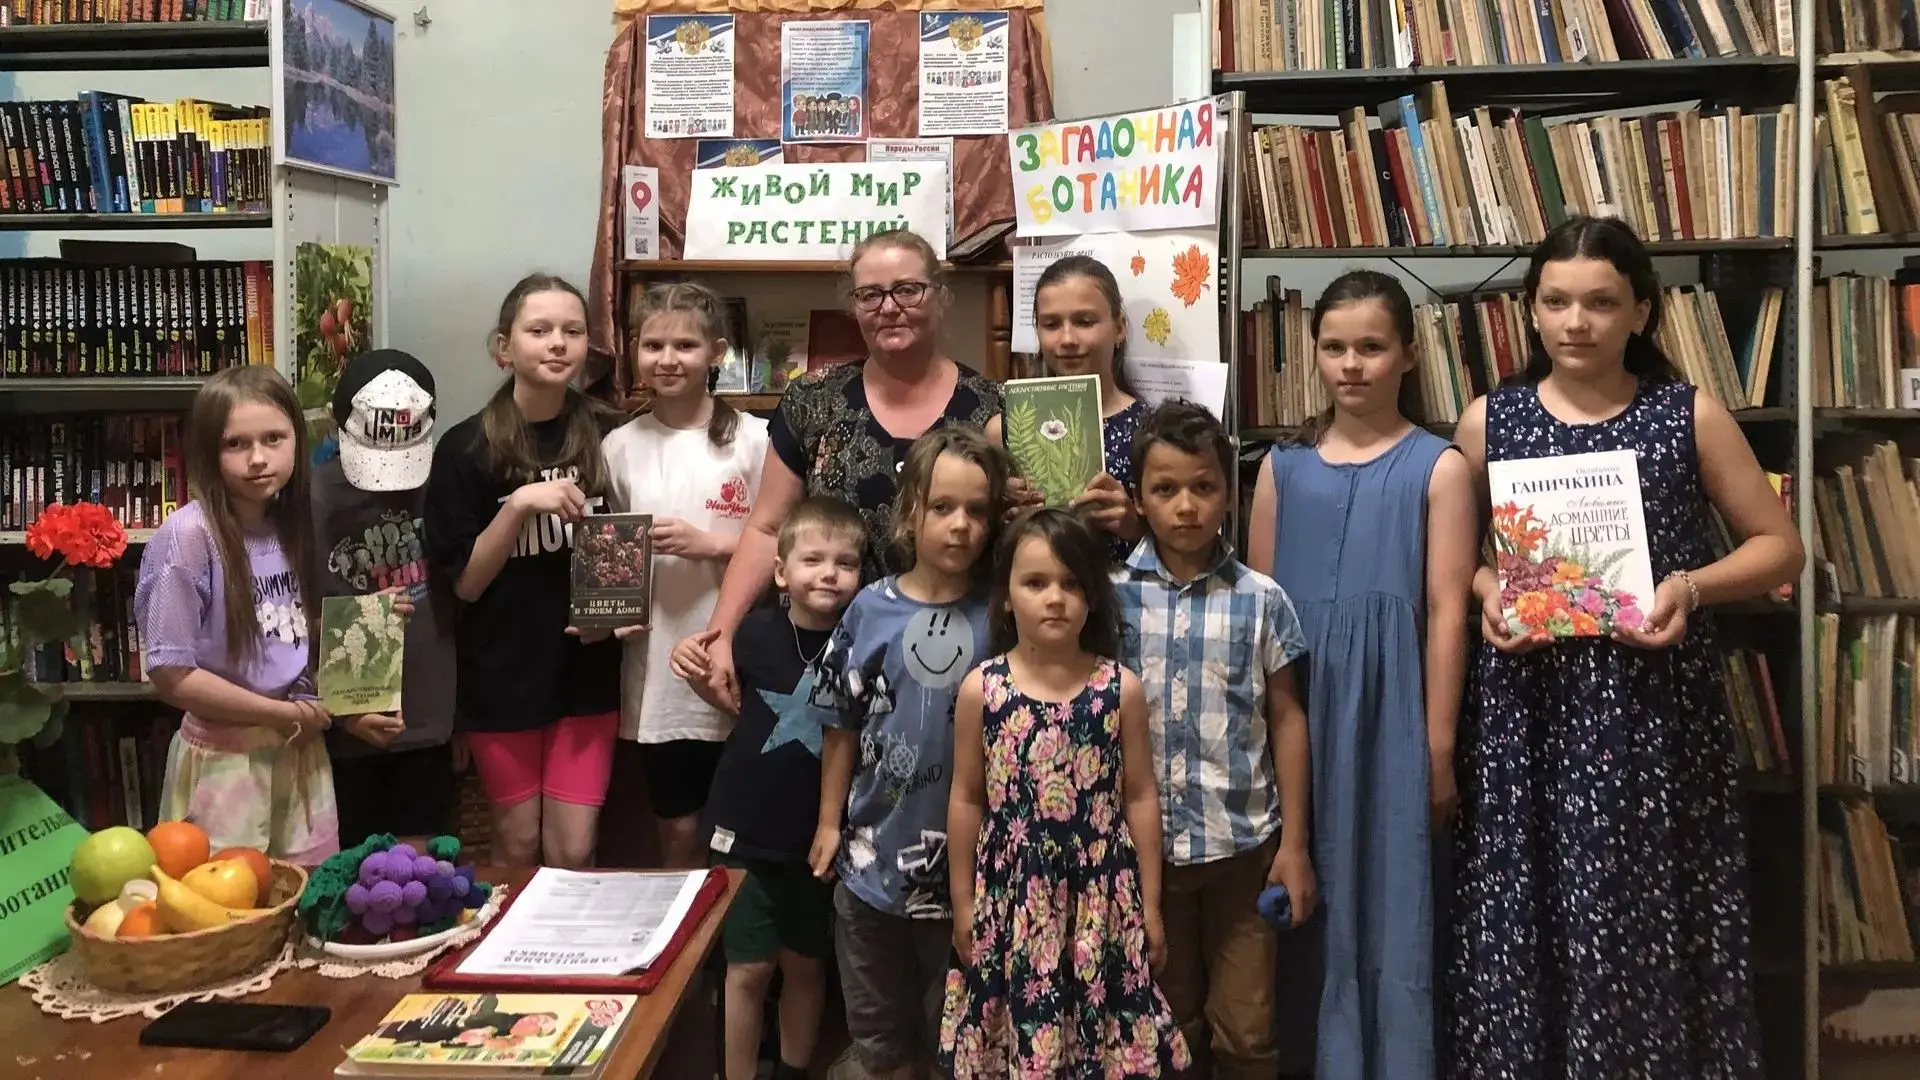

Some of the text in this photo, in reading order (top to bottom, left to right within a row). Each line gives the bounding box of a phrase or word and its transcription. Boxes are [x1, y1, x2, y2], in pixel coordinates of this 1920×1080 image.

[1015, 103, 1213, 172] ЗАГАДОЧНАЯ
[710, 168, 922, 206] ЖИВОЙ МИР
[1026, 163, 1204, 224] БОТАНИКА
[381, 408, 411, 425] NO
[1511, 473, 1623, 494] ГАНИЧКИНА
[1549, 507, 1628, 527] ДОМАШНИЕ
[1571, 524, 1631, 546] ЦВЕТЫ
[616, 606, 642, 614] ДОМЕ
